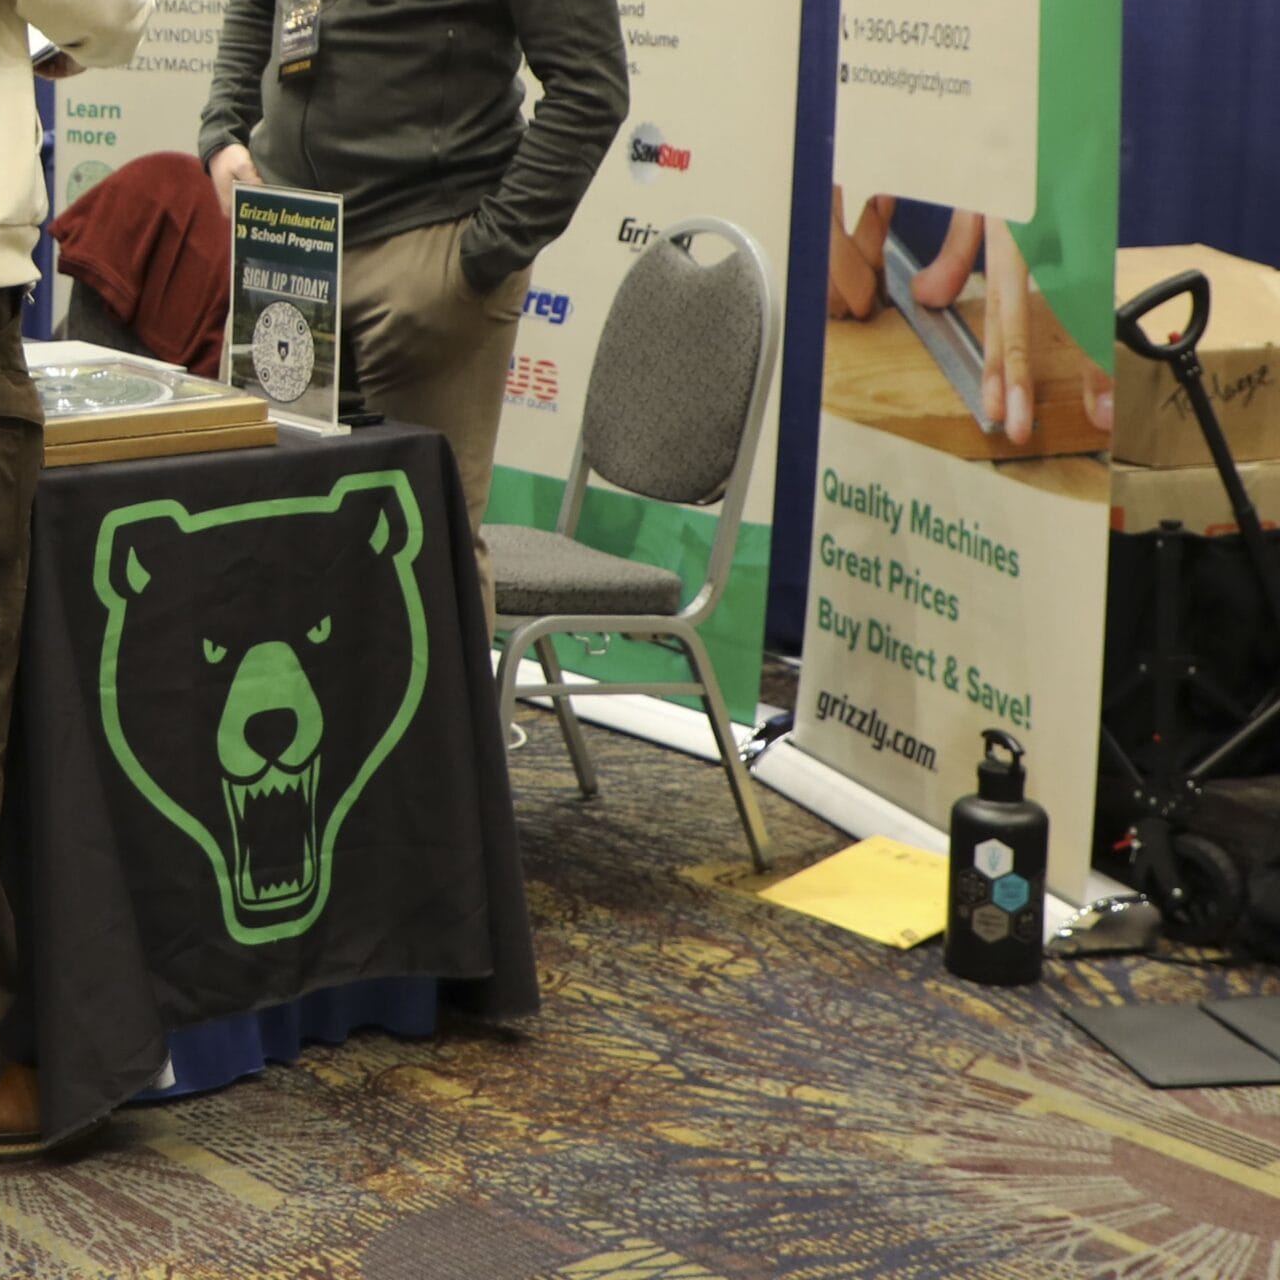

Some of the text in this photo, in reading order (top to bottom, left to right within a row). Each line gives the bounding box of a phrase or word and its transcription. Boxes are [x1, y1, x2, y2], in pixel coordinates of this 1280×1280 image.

[628, 29, 680, 48] Volume
[66, 98, 122, 119] Learn
[66, 129, 117, 145] more
[239, 202, 279, 226] Grizzly
[250, 227, 335, 253] School Program
[243, 266, 330, 300] SIGN UP TODAY!
[522, 290, 570, 325] reg
[822, 467, 1020, 578] Quality Machines
[820, 533, 960, 622] Great Prices
[818, 596, 1033, 731] Buy Direct & Save!
[815, 689, 938, 773] grizzly.com
